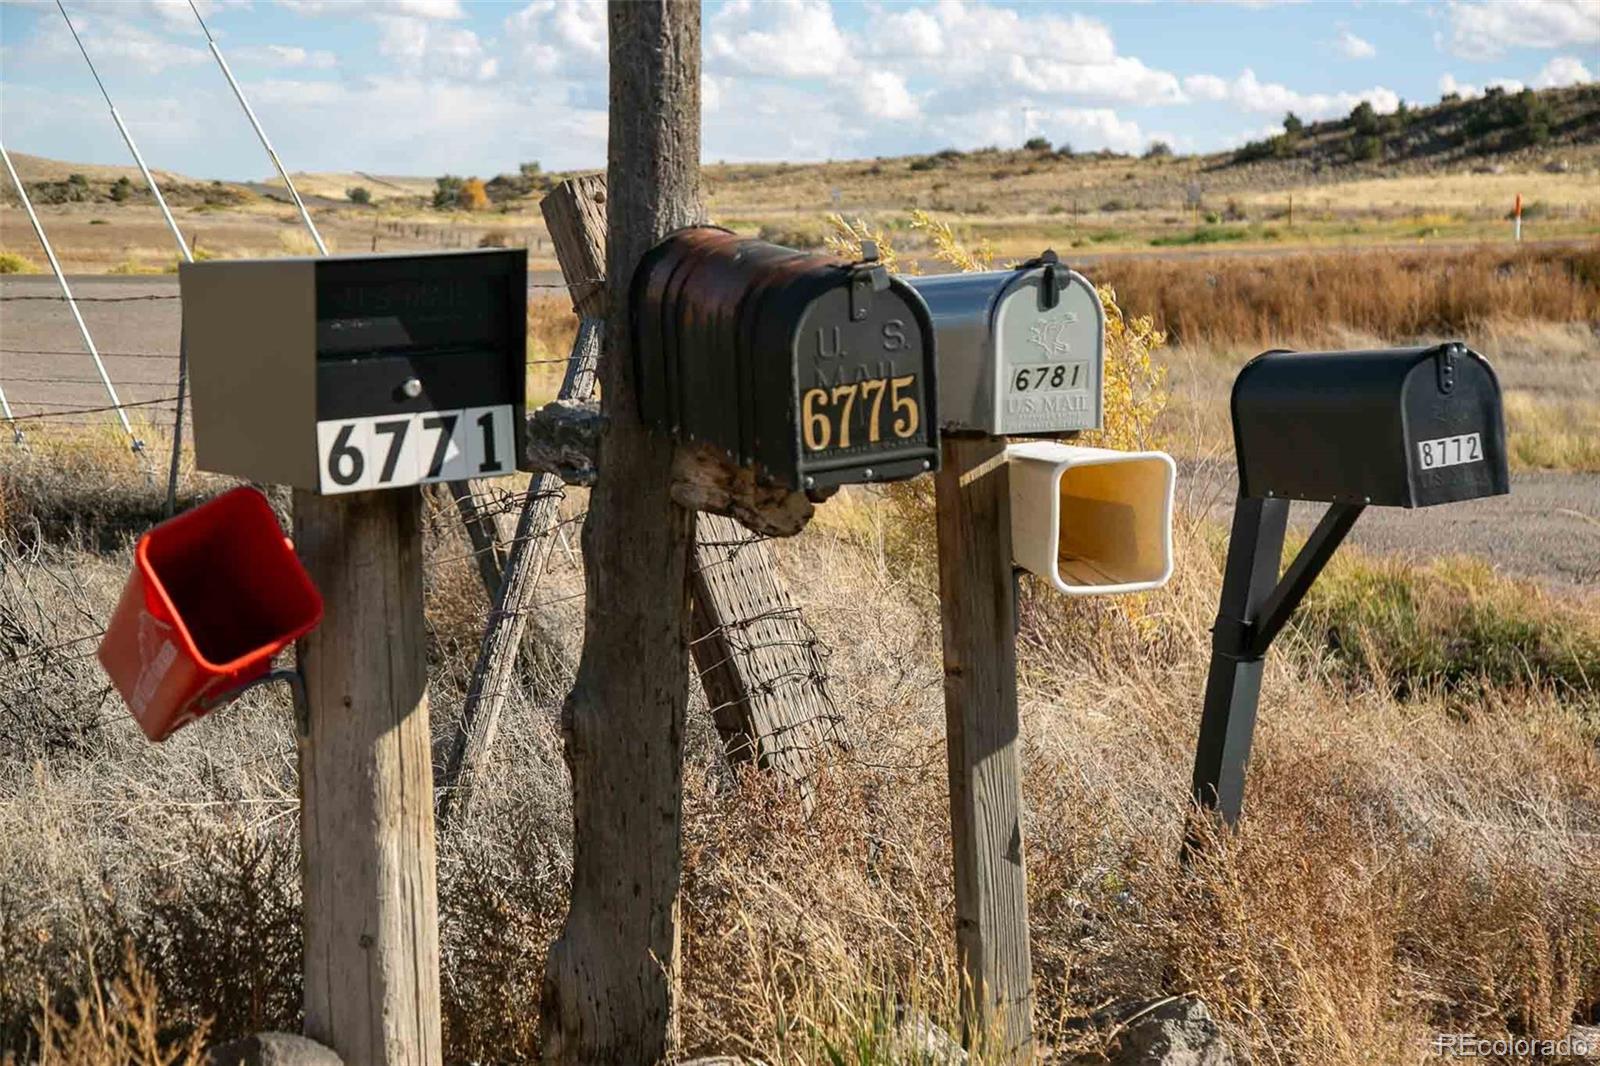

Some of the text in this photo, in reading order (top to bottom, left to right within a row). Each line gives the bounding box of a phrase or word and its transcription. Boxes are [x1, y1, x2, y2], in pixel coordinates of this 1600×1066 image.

[1015, 365, 1079, 391] 6781
[802, 375, 919, 451] 6775
[327, 412, 503, 486] 6771
[1422, 436, 1479, 467] 8772
